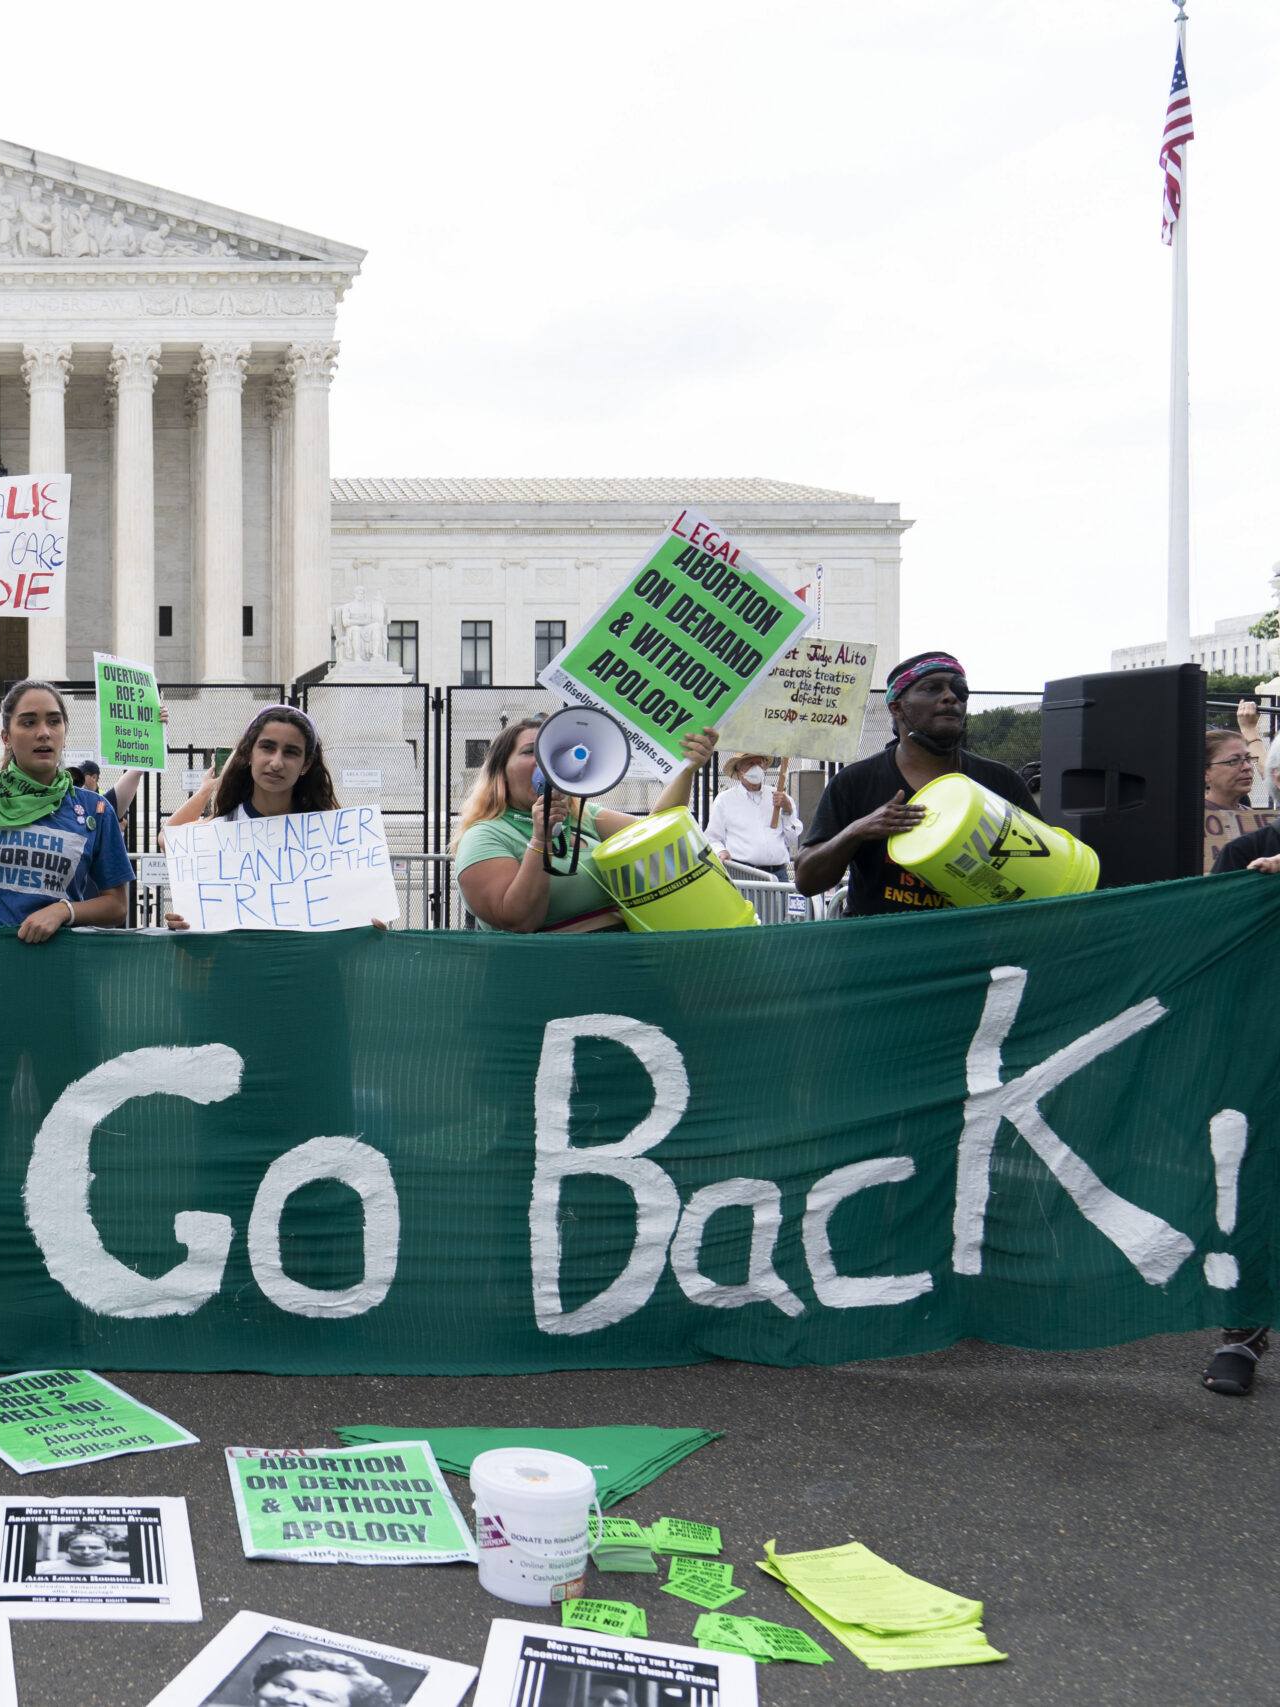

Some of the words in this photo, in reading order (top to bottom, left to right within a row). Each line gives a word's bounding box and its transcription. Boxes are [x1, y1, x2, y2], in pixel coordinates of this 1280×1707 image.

[6, 482, 62, 520] LIE
[671, 510, 742, 569] LEGAL
[11, 531, 65, 570] CARE
[673, 544, 783, 637] ABORTION
[633, 569, 676, 610] ON
[665, 593, 763, 679] DEMAND
[609, 612, 634, 638] &
[630, 622, 731, 709] WITHOUT
[807, 645, 832, 667] Judge
[104, 666, 151, 688] OVERTURN
[815, 670, 856, 684] treatise
[117, 685, 135, 702] ROE
[138, 689, 144, 702] ?
[587, 649, 694, 735] APOLOGY
[784, 680, 796, 689] on
[800, 679, 812, 690] the
[813, 682, 841, 696] fetus
[791, 688, 823, 706] defeat
[109, 703, 134, 720] HELL
[138, 706, 153, 722] NO!
[811, 712, 847, 725] 2022AD
[115, 726, 131, 736] Rise
[134, 728, 142, 739] Up
[144, 729, 149, 738] 4
[117, 739, 149, 750] Abortion
[115, 752, 153, 767] Rights.org
[163, 825, 211, 854] WE
[214, 818, 284, 853] WERE
[285, 808, 384, 851] NEVER
[30, 852, 70, 874] OUR
[166, 854, 217, 882] THE
[219, 847, 308, 881] LAND
[198, 874, 340, 929] FREE
[25, 1042, 400, 1319] Go
[54, 1390, 70, 1402] ?
[63, 1399, 112, 1416] NO!
[24, 1421, 70, 1436] Rise
[71, 1418, 97, 1430] Up
[44, 1425, 126, 1447] Abortion
[48, 1434, 155, 1458] Rights.org
[228, 1449, 319, 1459] LEGAL
[259, 1455, 408, 1473] ABORTION
[247, 1475, 288, 1490] ON
[299, 1475, 434, 1493] DEMAND
[261, 1498, 281, 1514] &
[292, 1496, 433, 1516] WITHOUT
[283, 1521, 429, 1544] APOLOGY
[511, 1533, 541, 1544] DONATE
[578, 1600, 627, 1615] OVERTURN
[571, 1613, 597, 1623] HELL
[271, 1624, 431, 1671] RiseUp4AbortionRights.org
